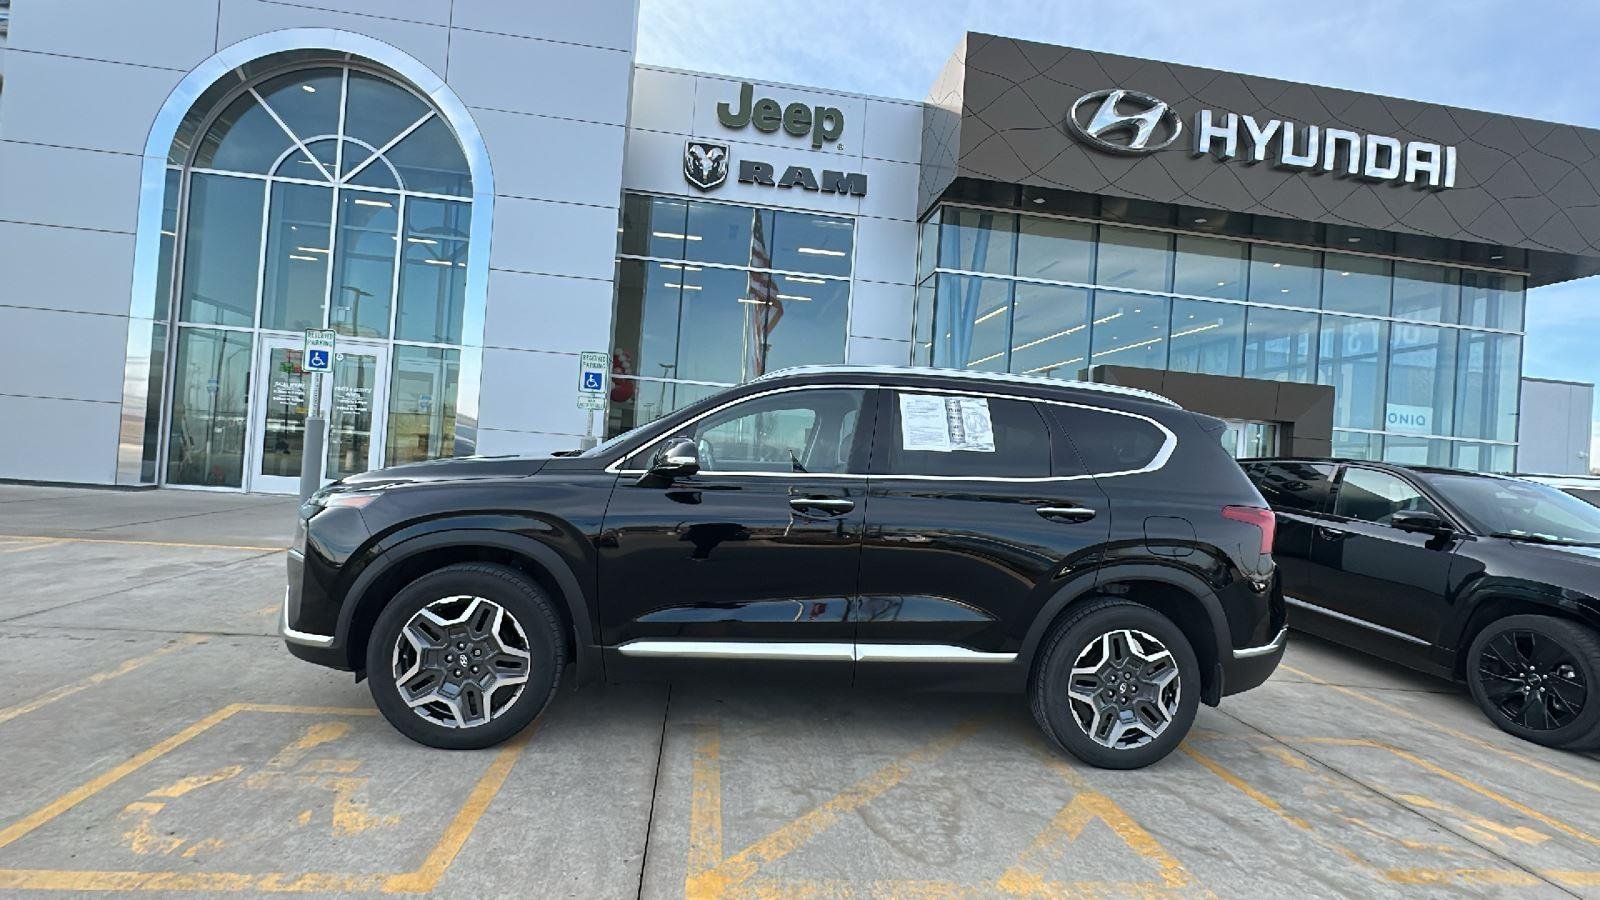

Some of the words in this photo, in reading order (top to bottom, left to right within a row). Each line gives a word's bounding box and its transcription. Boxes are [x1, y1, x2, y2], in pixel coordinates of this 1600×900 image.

[717, 82, 844, 148] Jeep
[738, 160, 868, 196] RAM
[1194, 109, 1457, 189] HYUNDAI
